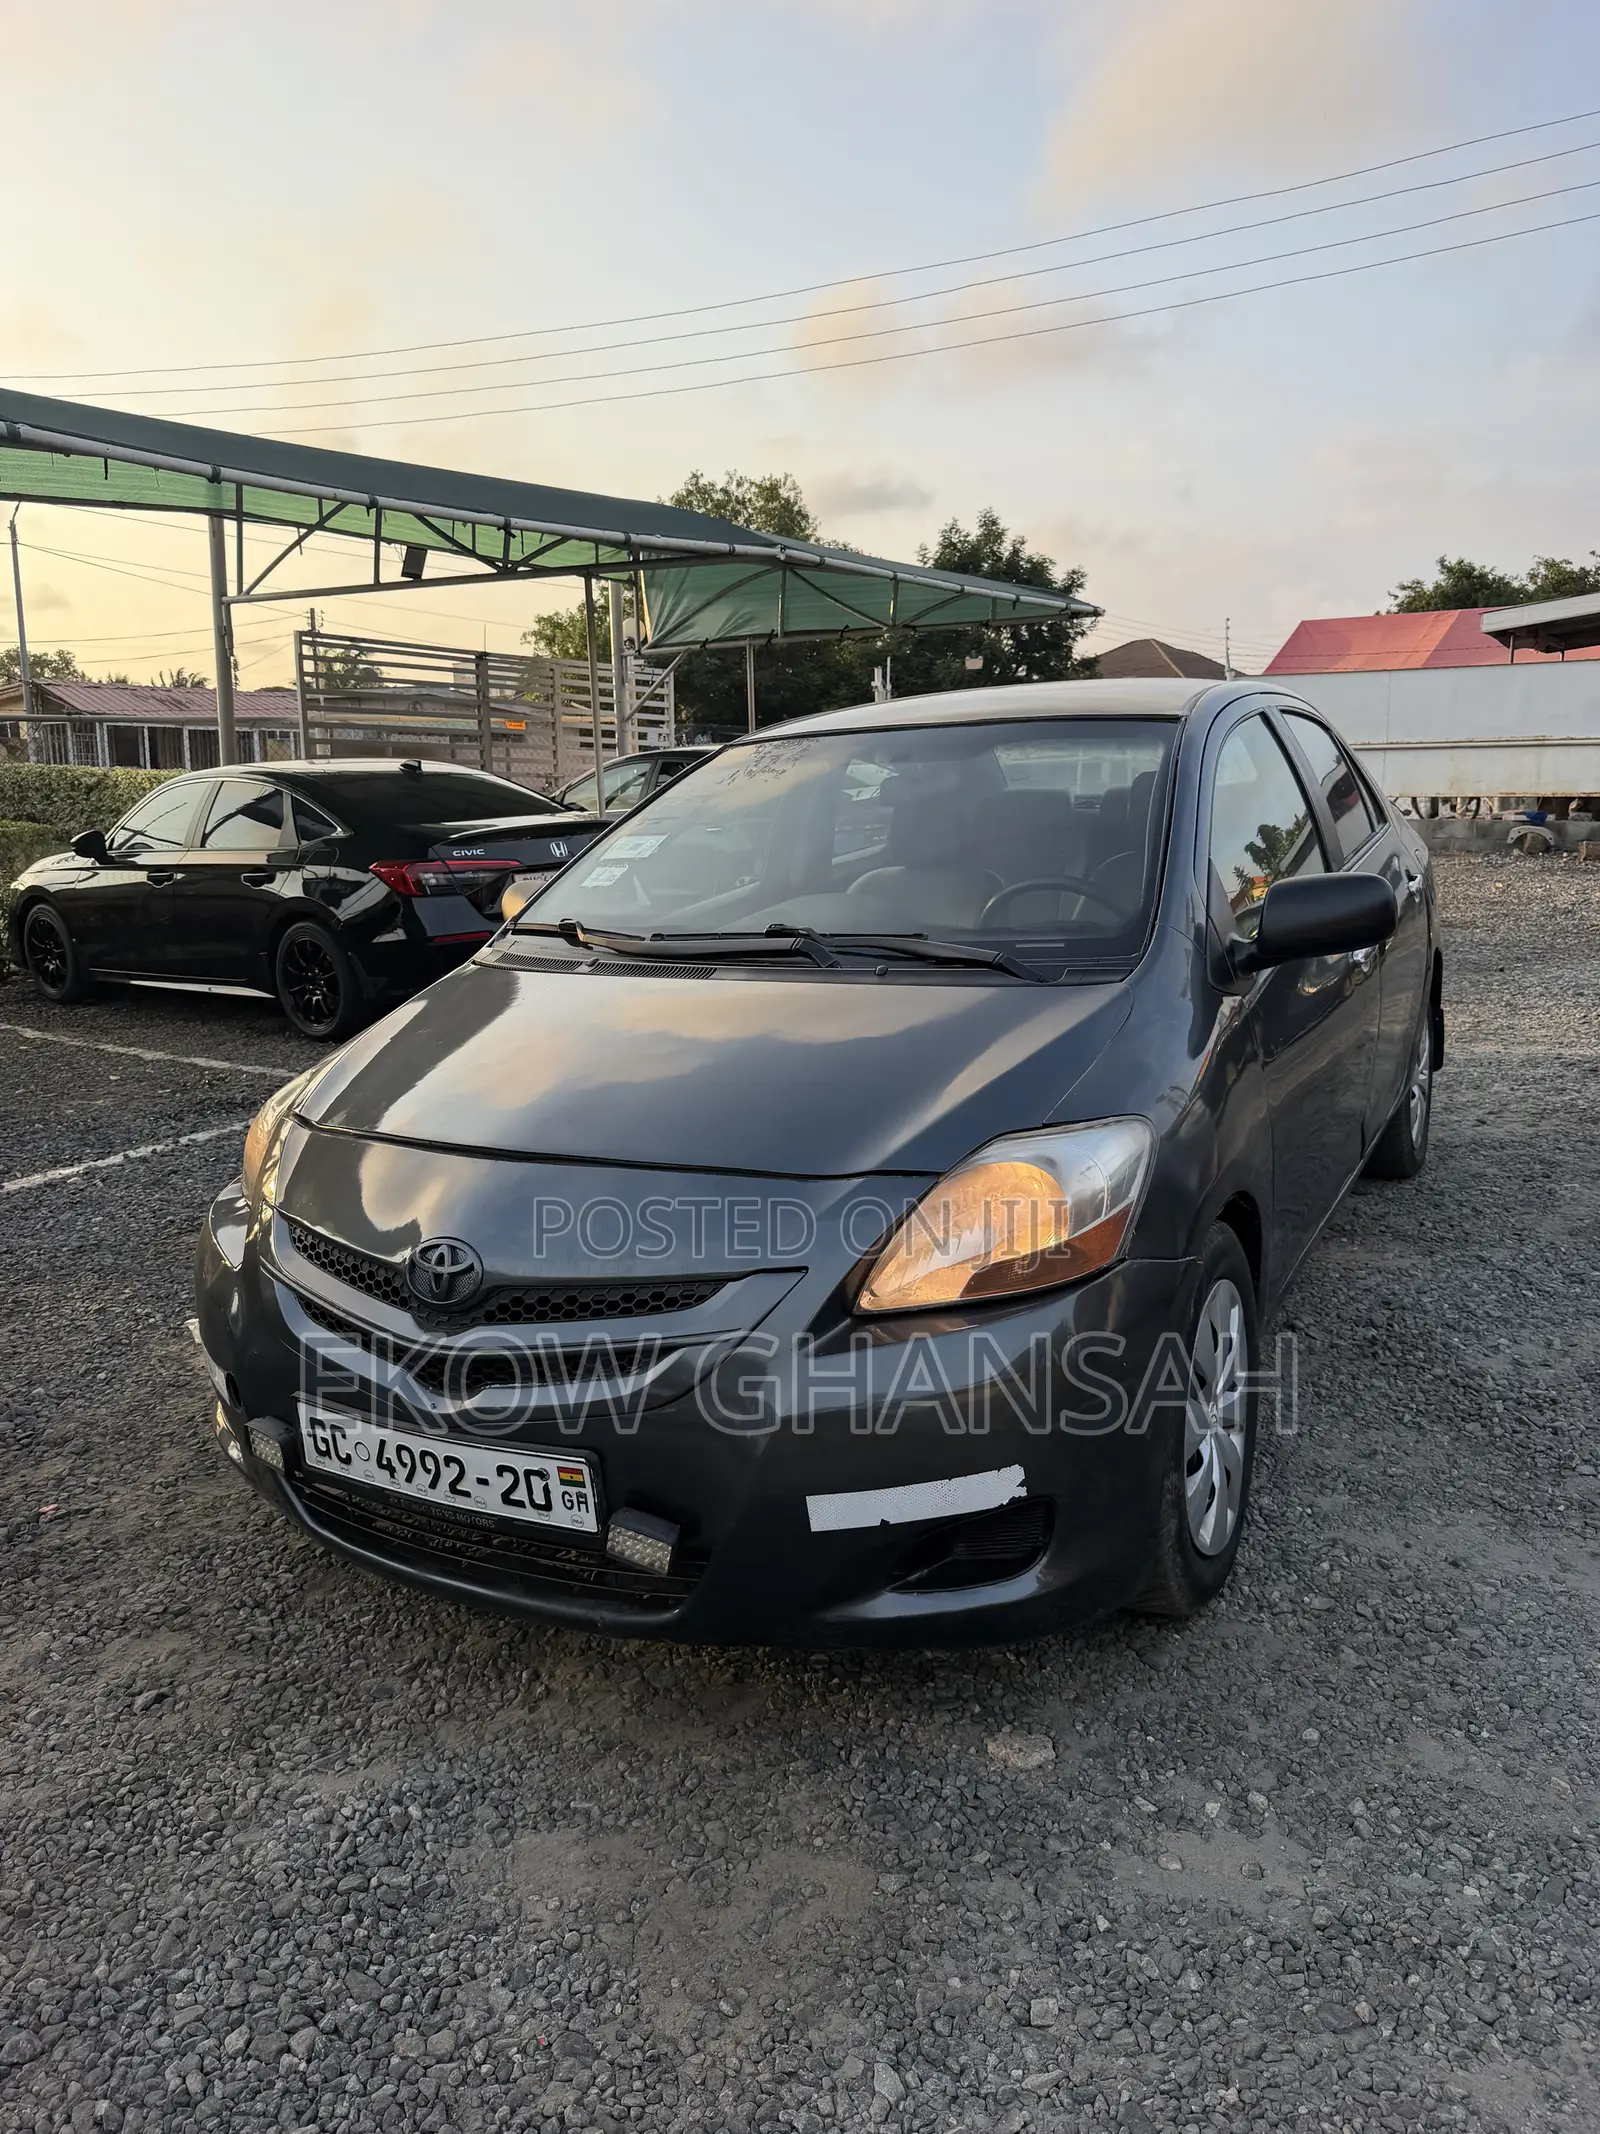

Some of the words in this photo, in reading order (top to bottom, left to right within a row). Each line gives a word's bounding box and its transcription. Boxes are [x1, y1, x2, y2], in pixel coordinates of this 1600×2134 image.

[452, 848, 485, 857] CIVIC
[309, 1416, 353, 1465] GC
[376, 1437, 553, 1512] 4992-20
[561, 1490, 590, 1514] GH
